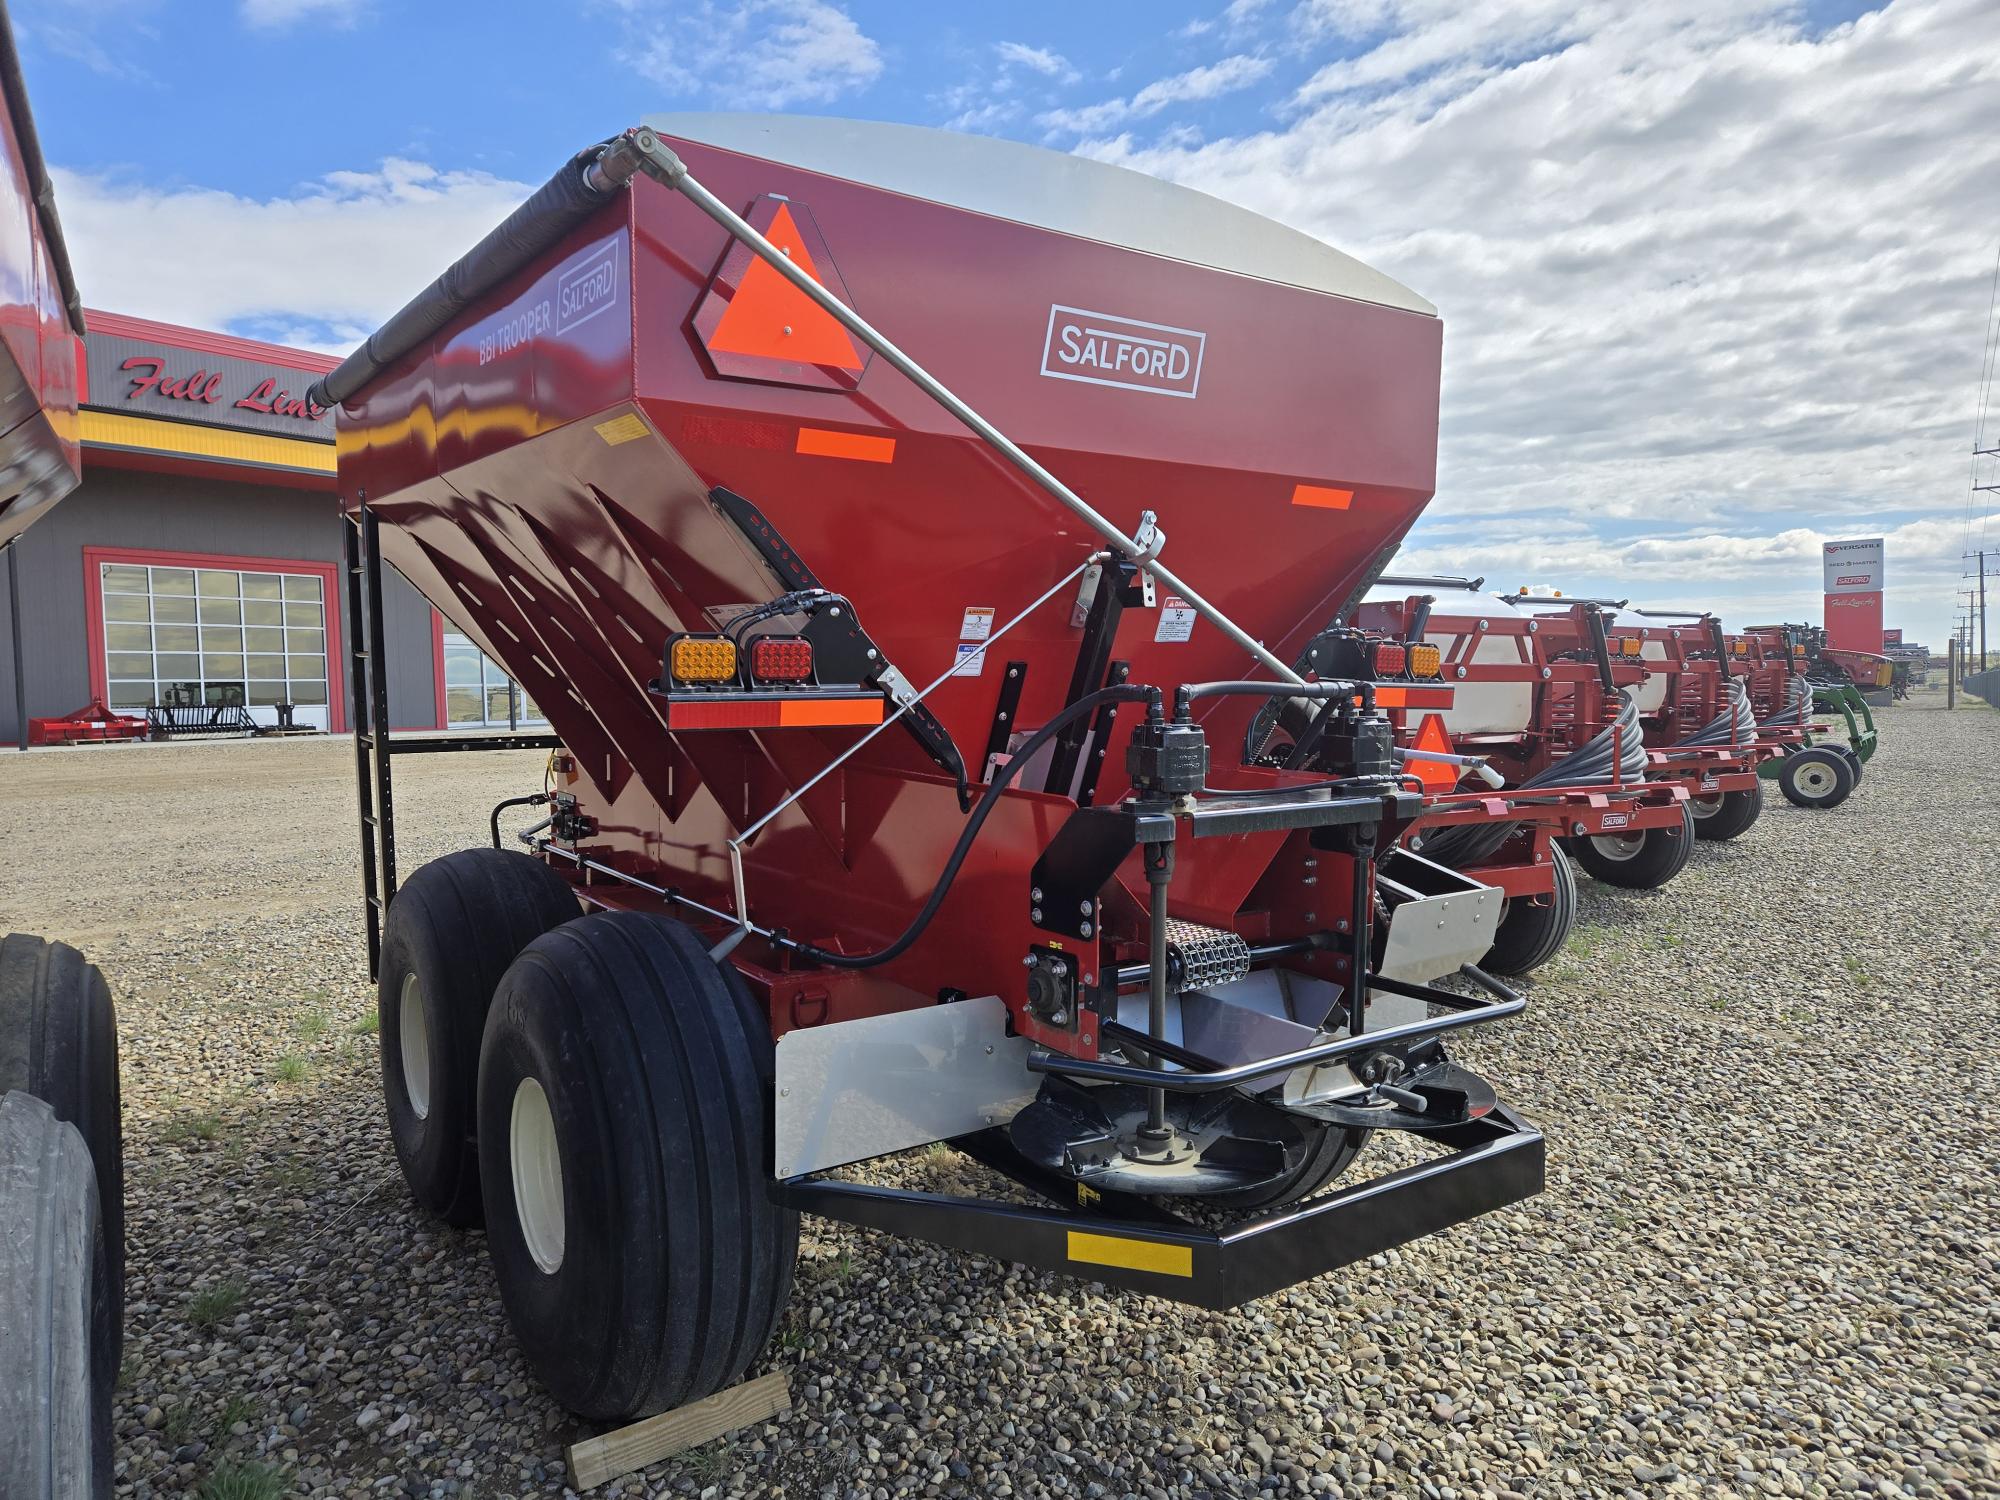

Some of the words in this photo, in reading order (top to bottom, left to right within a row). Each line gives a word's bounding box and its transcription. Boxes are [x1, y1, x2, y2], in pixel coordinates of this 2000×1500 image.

[561, 260, 613, 319] SALFORD
[479, 332, 496, 366] BBI
[497, 300, 551, 355] TROOPER
[1057, 325, 1190, 380] SALFORD
[121, 357, 223, 404] Full
[1603, 815, 1626, 826] SALFORD
